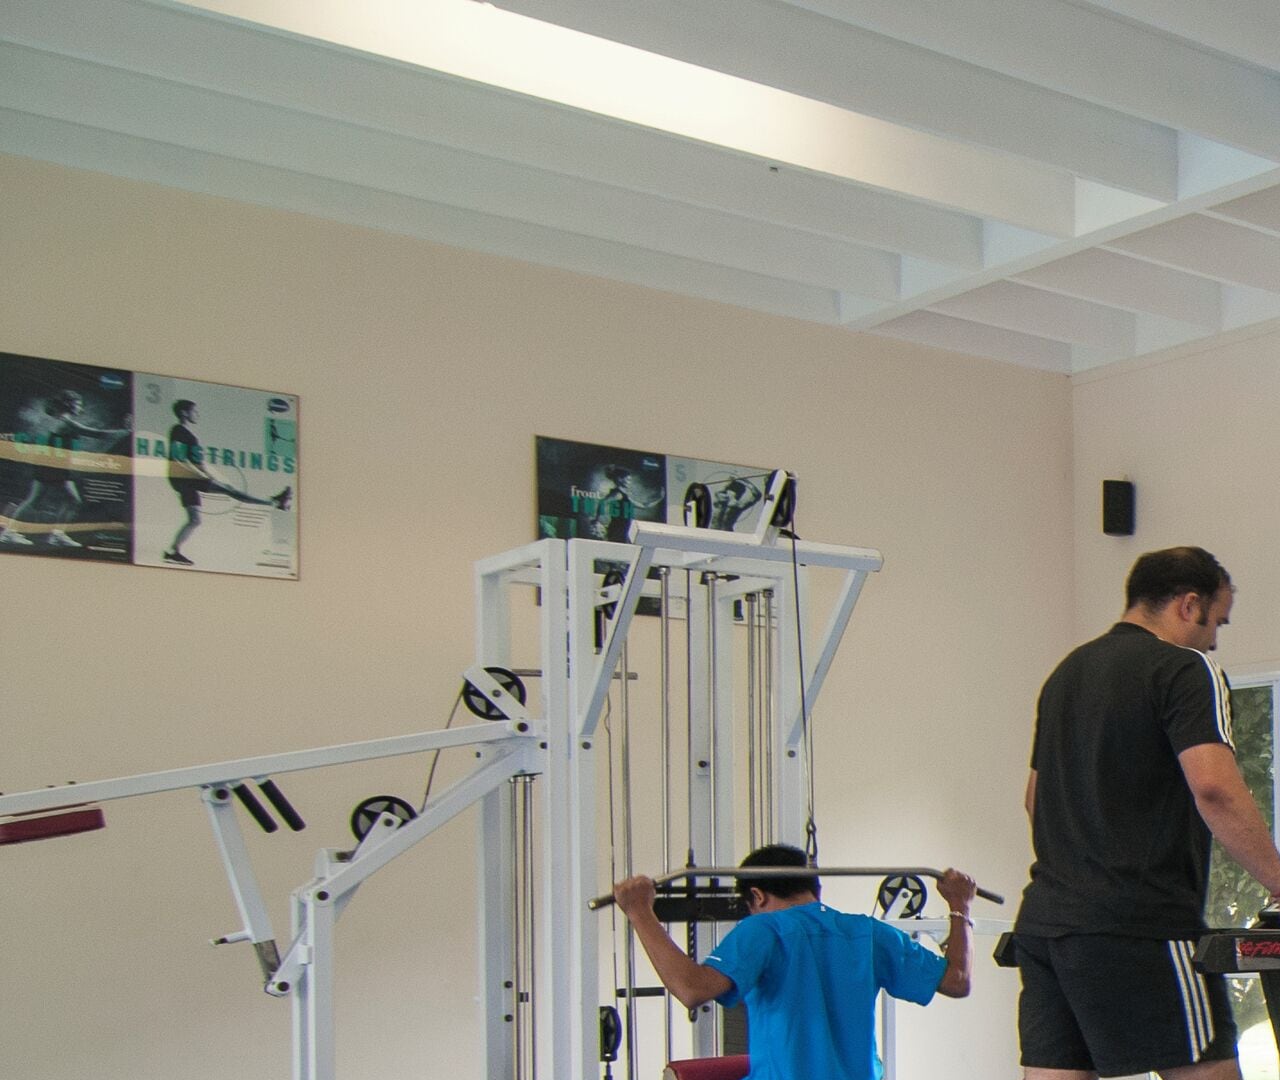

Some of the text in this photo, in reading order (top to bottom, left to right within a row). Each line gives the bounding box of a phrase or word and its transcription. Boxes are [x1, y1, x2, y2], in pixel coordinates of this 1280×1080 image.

[136, 437, 295, 474] HAMSTRINGS
[571, 484, 604, 500] front
[571, 495, 635, 520] THIGH
